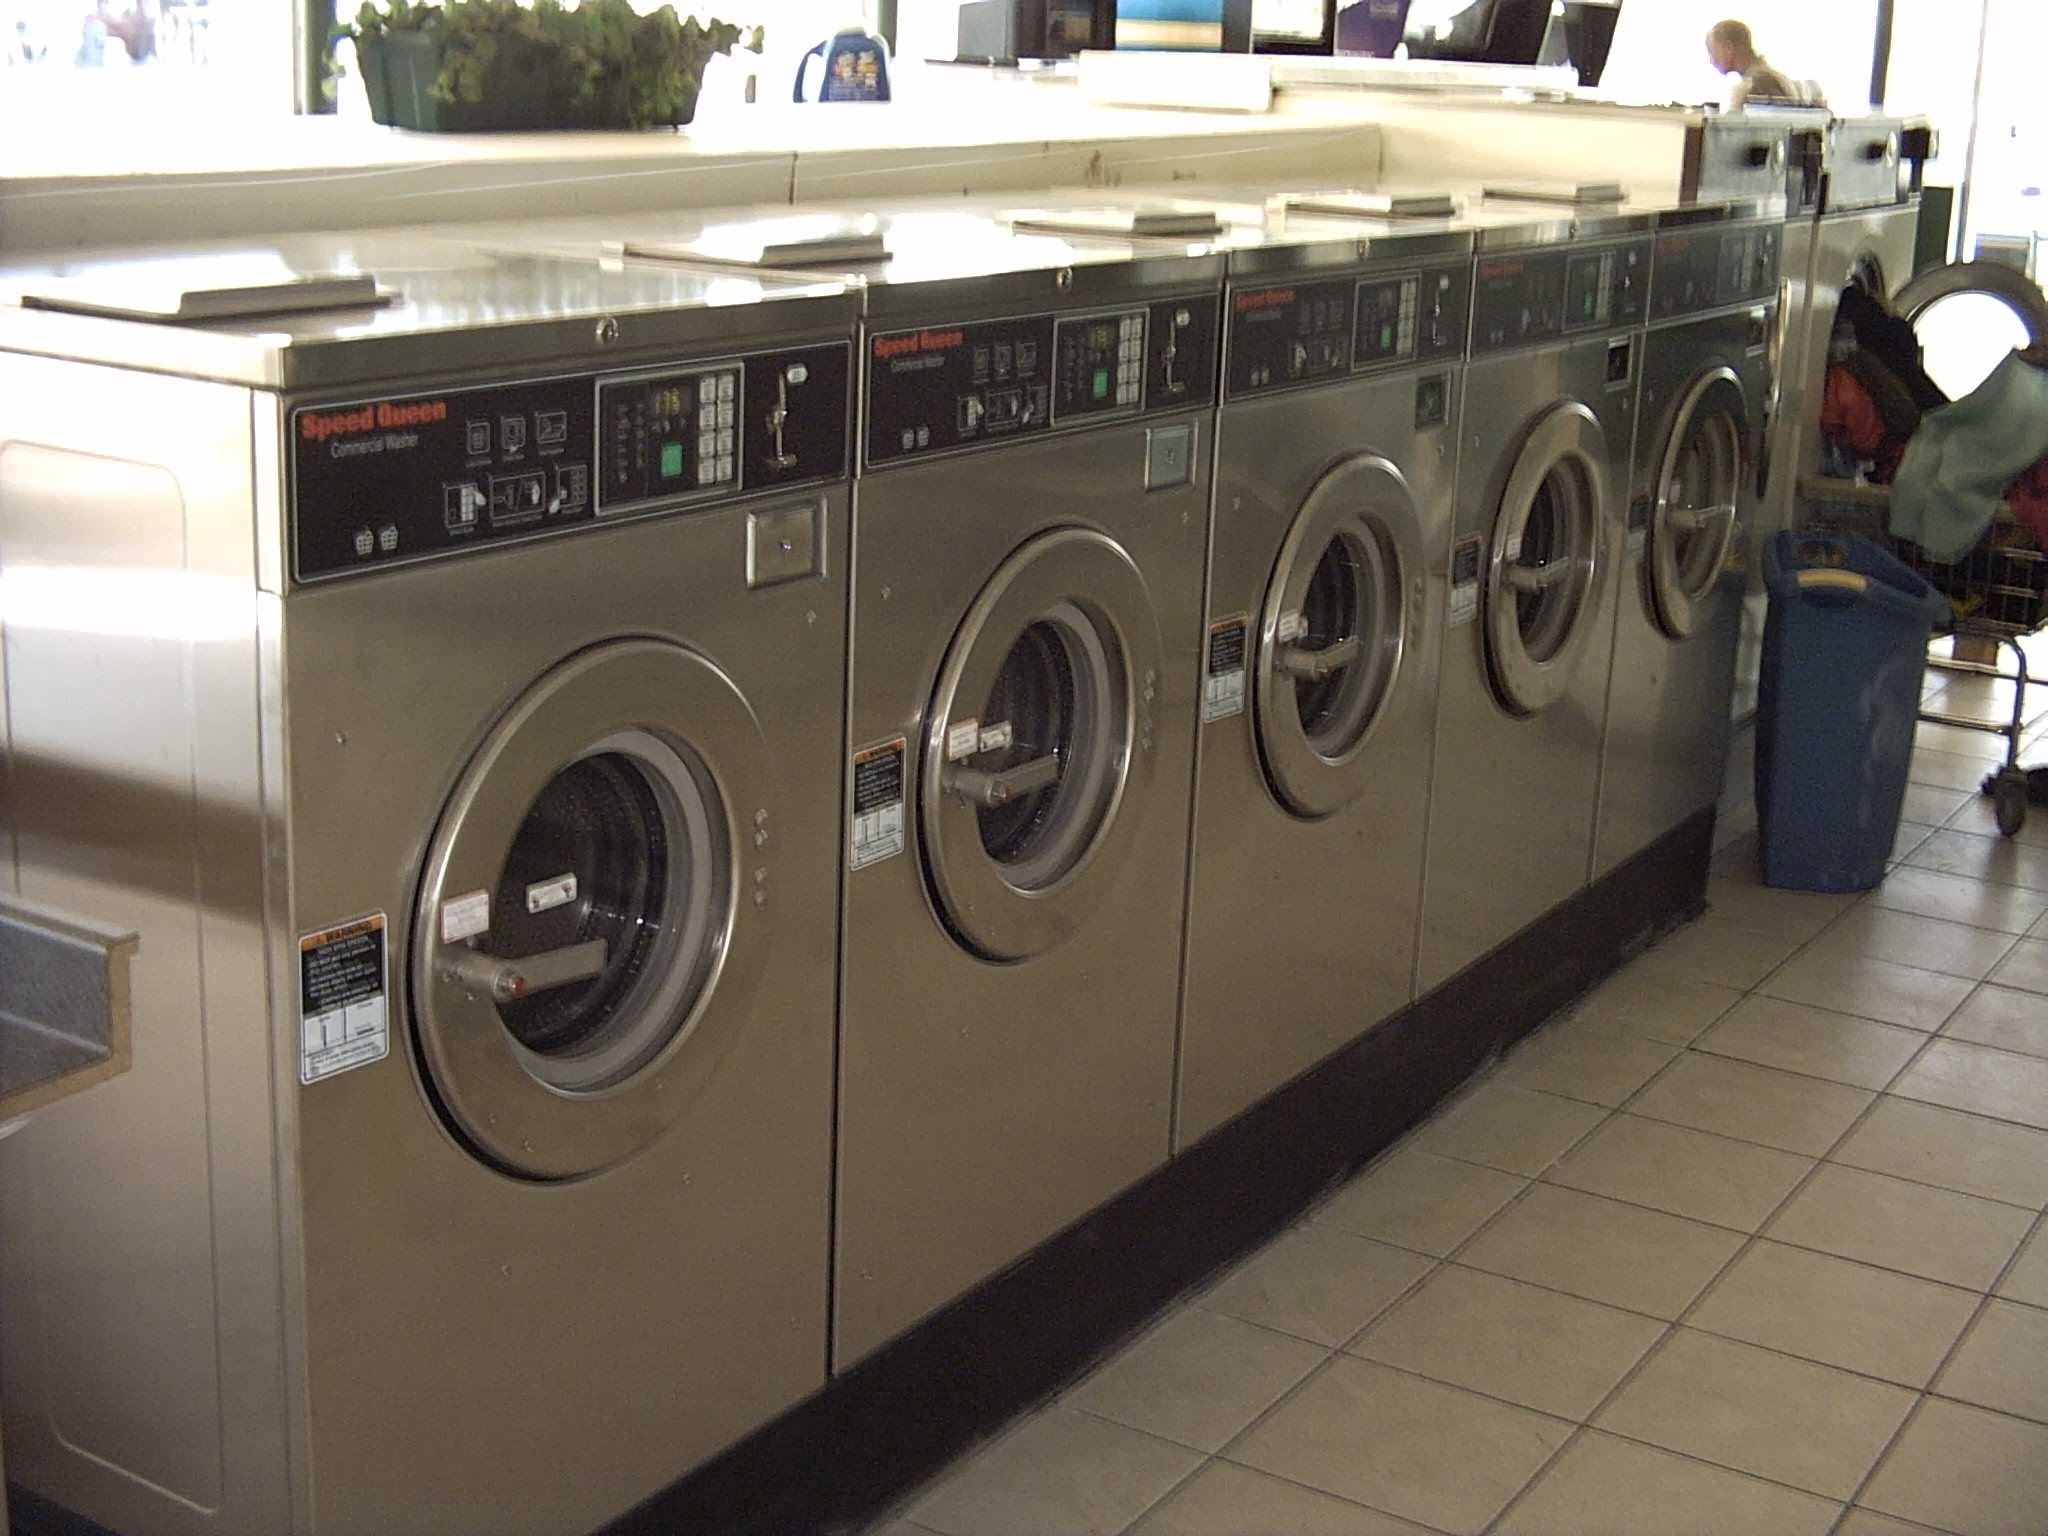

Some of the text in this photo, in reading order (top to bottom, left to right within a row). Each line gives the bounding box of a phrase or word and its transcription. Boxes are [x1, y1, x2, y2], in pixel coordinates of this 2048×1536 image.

[303, 400, 447, 439] Speed Queen
[331, 437, 386, 459] Commercial
